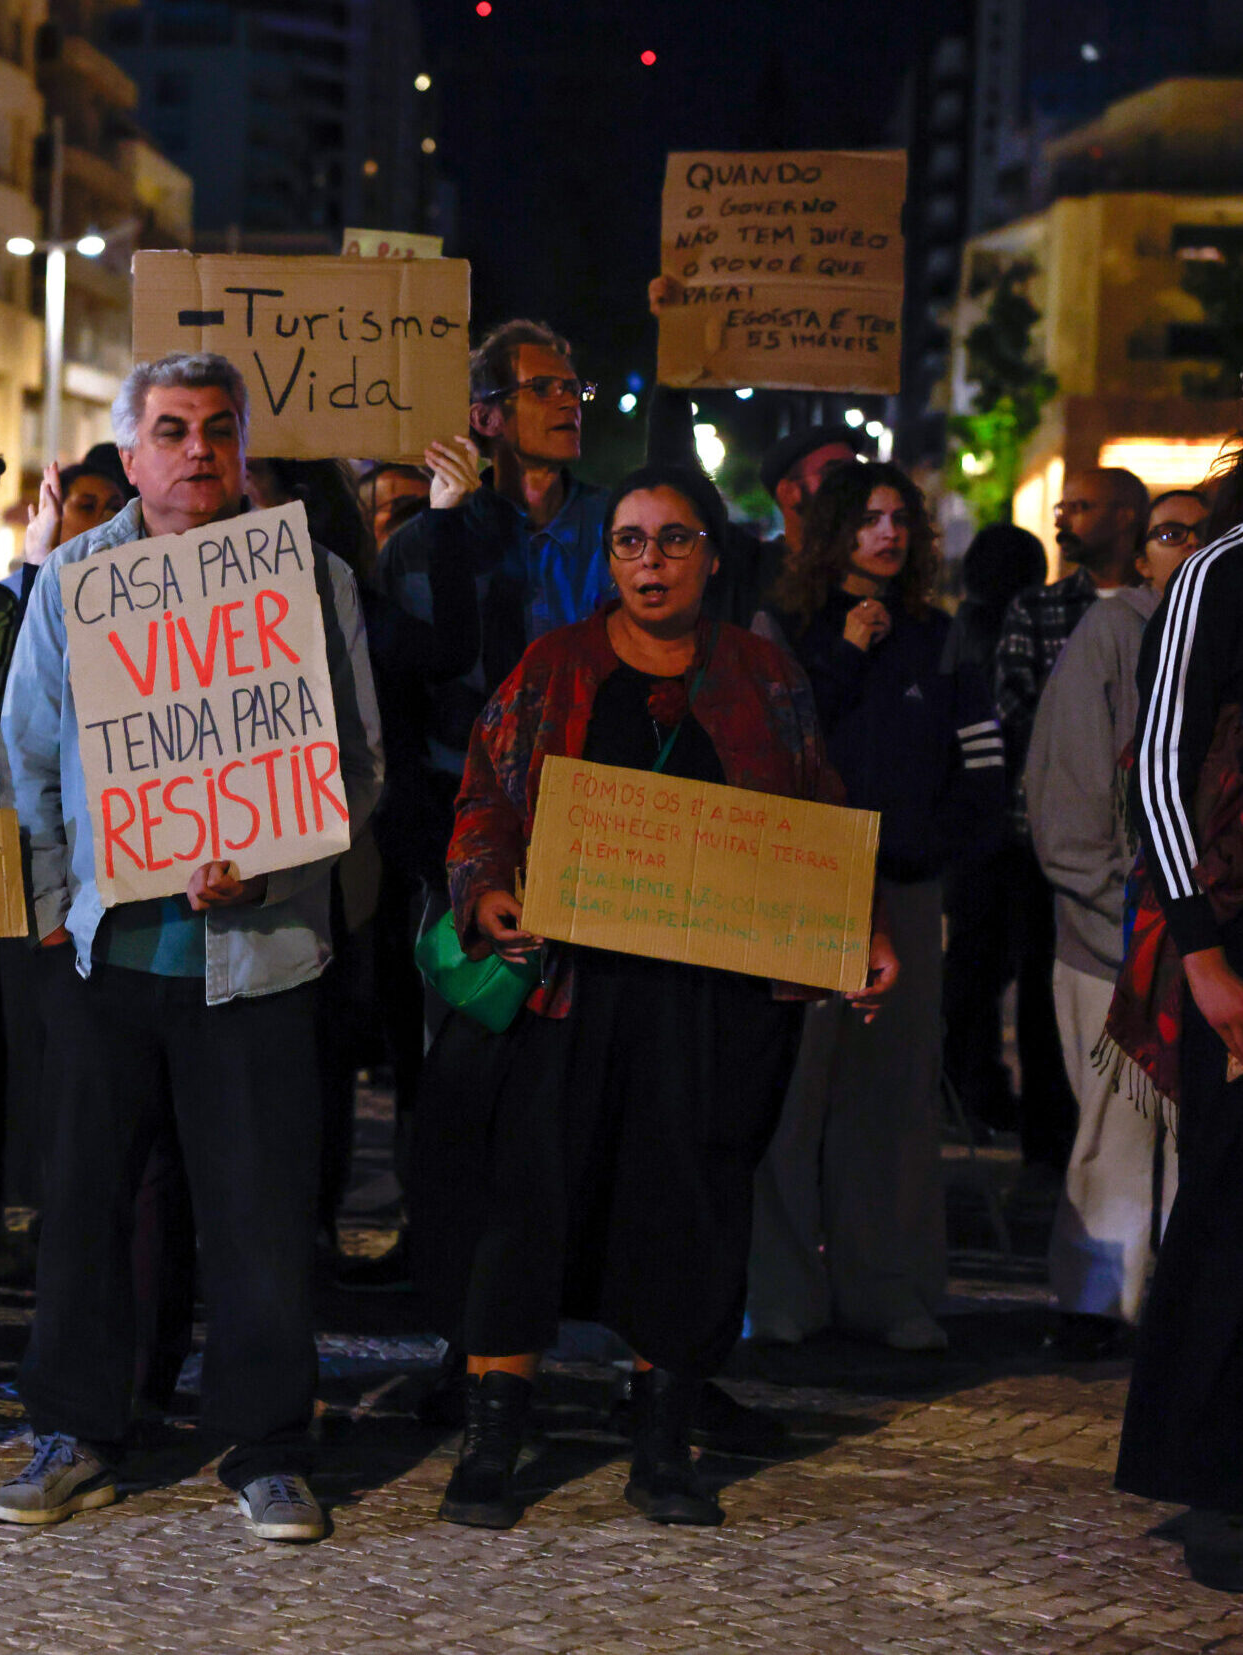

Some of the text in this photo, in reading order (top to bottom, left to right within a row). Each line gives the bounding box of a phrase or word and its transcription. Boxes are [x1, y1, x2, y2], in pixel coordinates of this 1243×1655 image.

[686, 163, 822, 192] QUANDO
[720, 198, 837, 216] GOVERNO
[738, 226, 794, 245] TEM
[711, 257, 783, 273] POVO
[818, 258, 866, 276] QUE
[224, 287, 461, 342] Turismo
[253, 347, 413, 416] Vida
[74, 519, 304, 624] CASA PARA
[85, 675, 323, 774] TENDA PARA
[572, 772, 645, 807] FOMOS
[653, 791, 680, 814] OS
[777, 818, 791, 832] A
[568, 804, 839, 871] CONHECER MUITAS TERRAS
